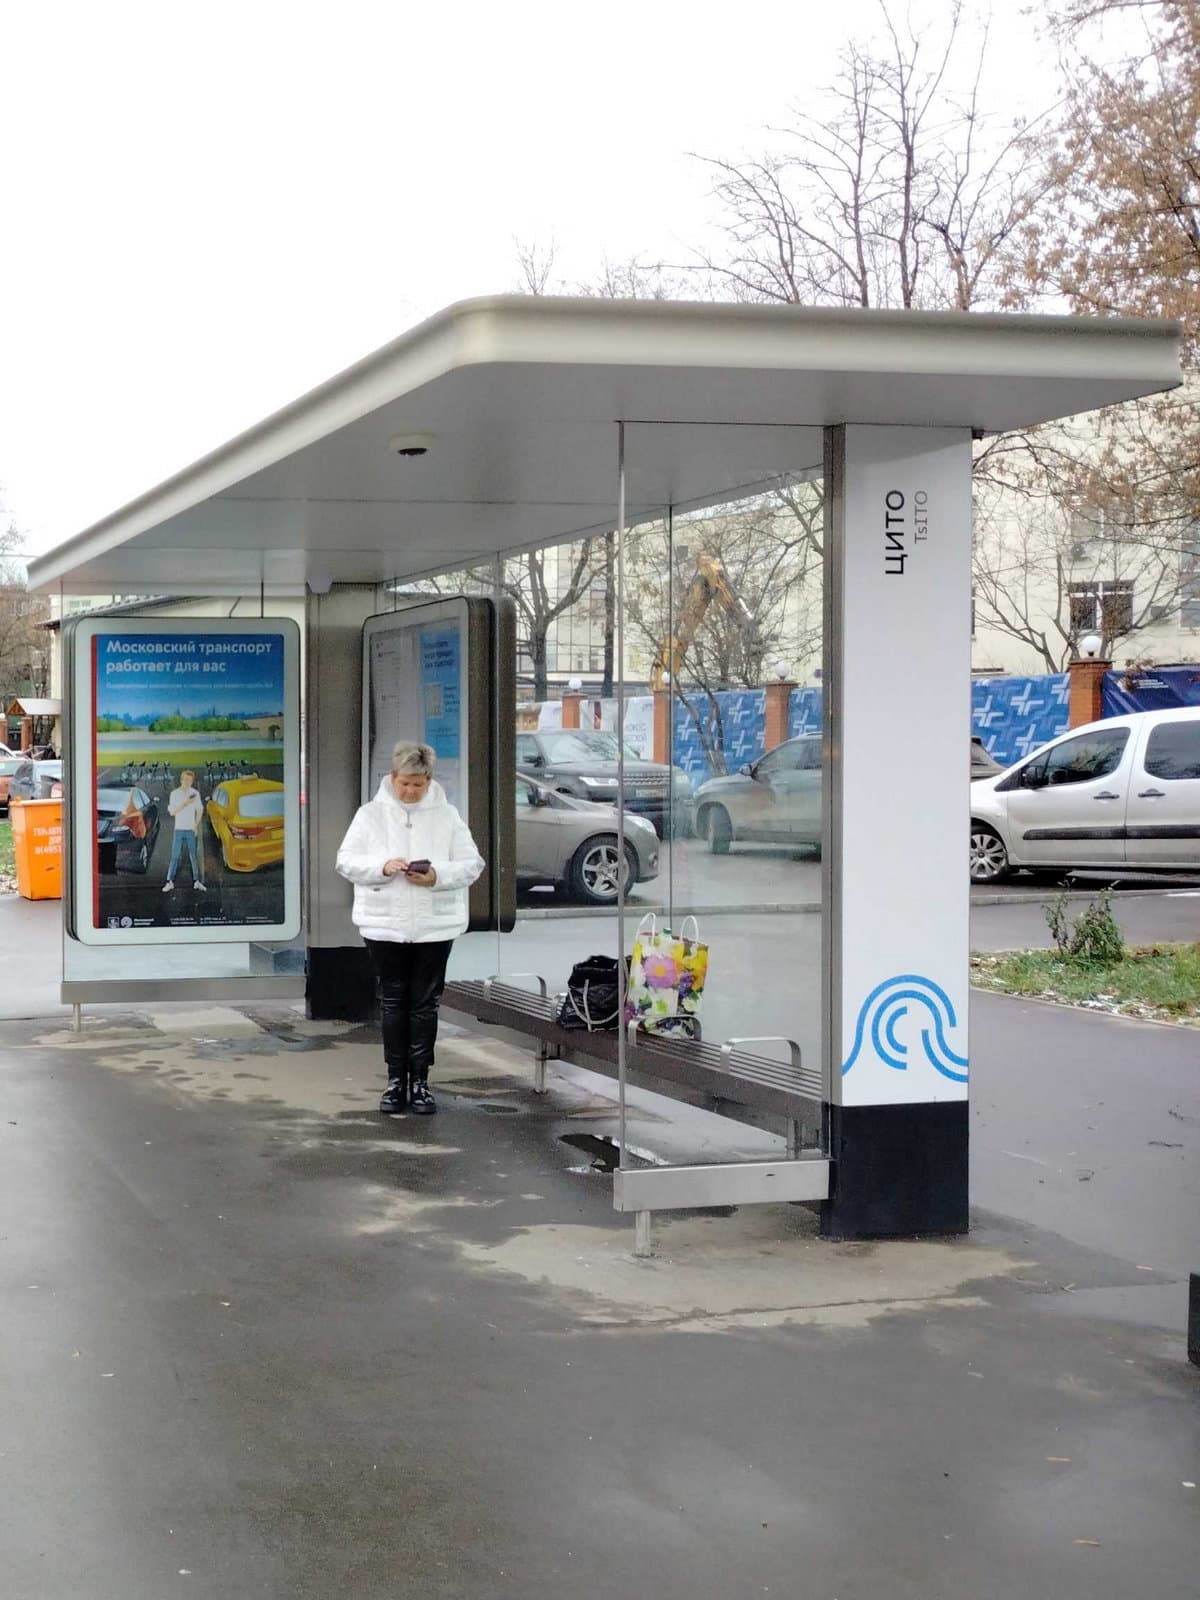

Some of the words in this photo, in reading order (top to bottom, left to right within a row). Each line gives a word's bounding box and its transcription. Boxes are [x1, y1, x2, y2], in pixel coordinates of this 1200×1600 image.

[885, 489, 908, 575] ЦИТО
[106, 640, 196, 654] Московский
[199, 643, 273, 655] транспорт
[106, 659, 171, 674] работает
[174, 662, 200, 674] для
[203, 662, 227, 672] вас
